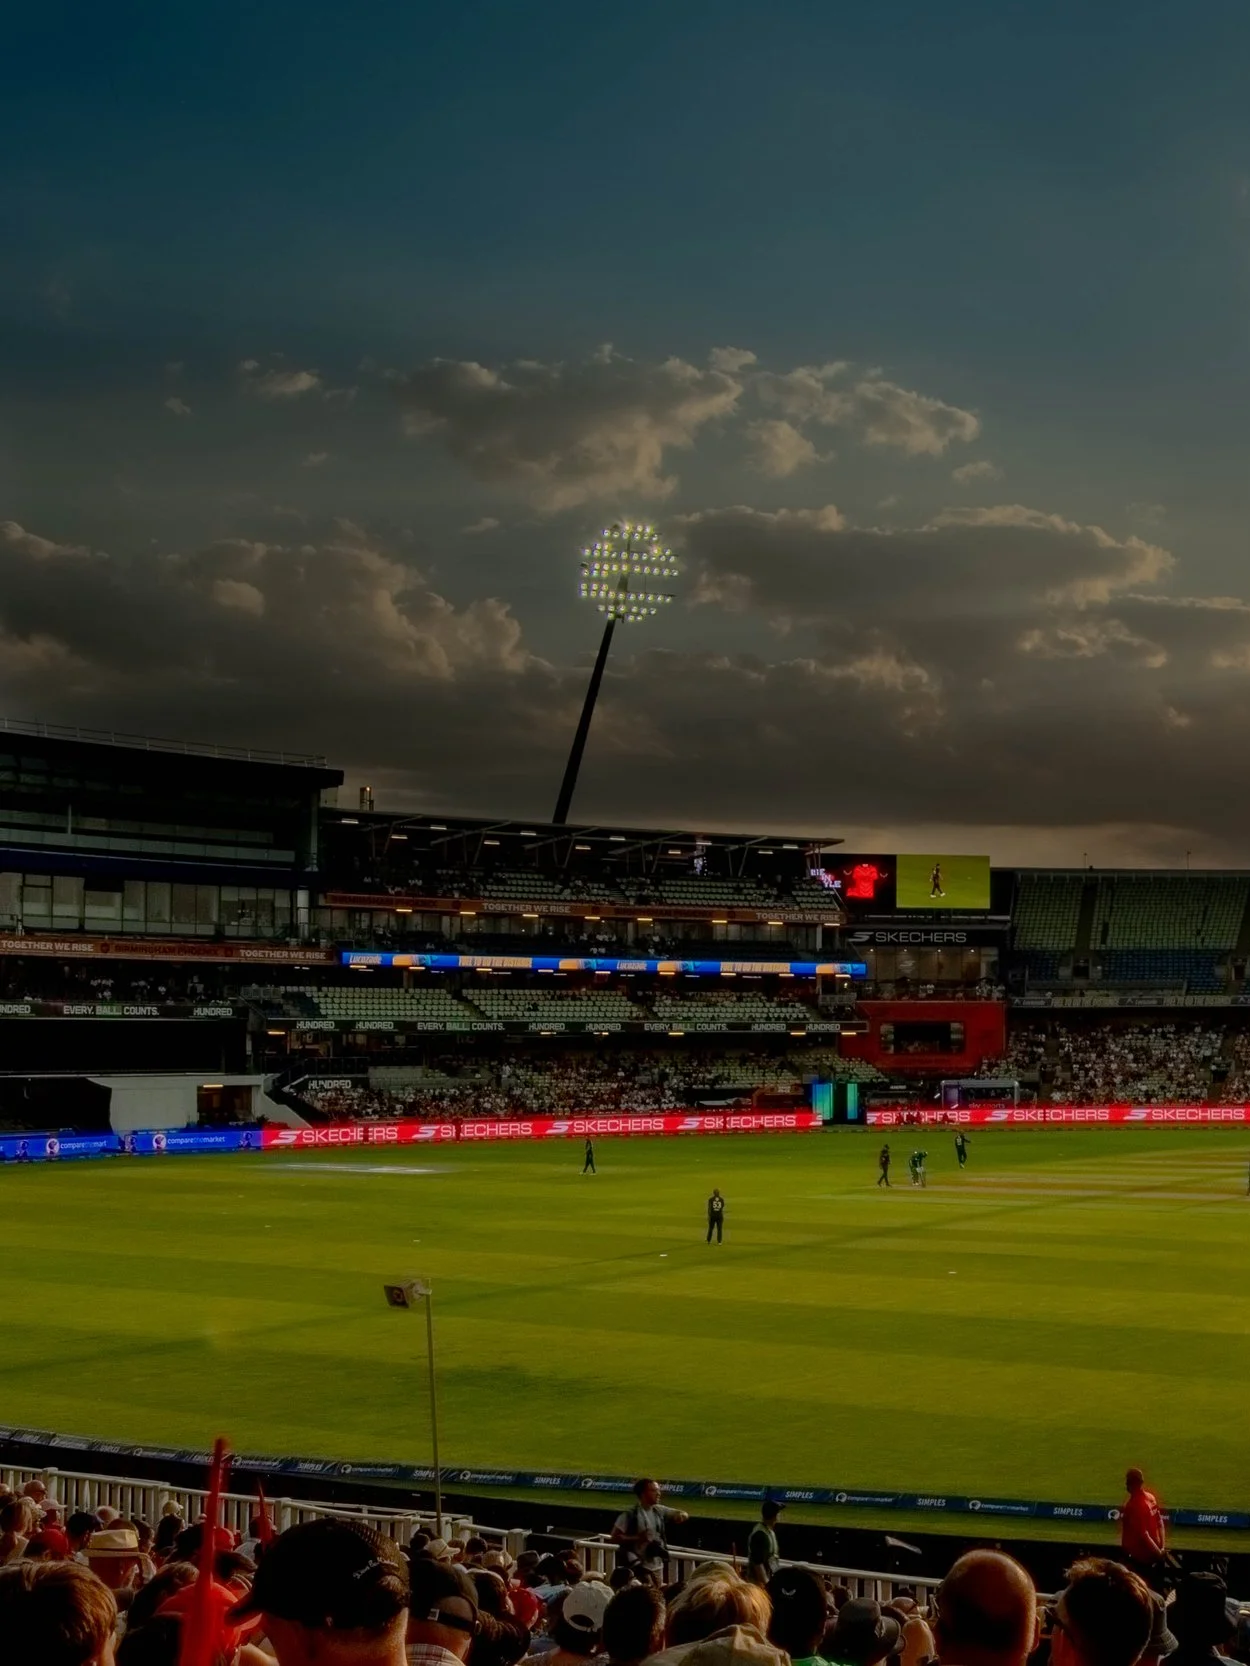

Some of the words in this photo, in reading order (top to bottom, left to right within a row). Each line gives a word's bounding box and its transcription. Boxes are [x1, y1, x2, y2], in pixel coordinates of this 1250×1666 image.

[482, 902, 533, 912] TOGETHER
[534, 904, 550, 912] WE
[551, 904, 571, 913] RISE
[755, 911, 803, 921] TOGETHER
[804, 912, 819, 921] WE
[820, 913, 840, 921] RISE
[875, 931, 967, 943] SKECHERS
[1, 940, 53, 951] TOGETHER
[54, 942, 71, 951] WE
[72, 943, 94, 952] RISE
[239, 949, 289, 959] TOGETHER
[290, 950, 305, 959] WE
[306, 951, 326, 960] RISE
[123, 1006, 160, 1016] COUNTS.
[193, 1007, 233, 1016] HUNDRED
[296, 1020, 336, 1030] HUNDRED
[355, 1021, 395, 1030] HUNDRED
[471, 1022, 506, 1031] COUNTS.
[528, 1022, 566, 1031] HUNDRED
[585, 1023, 622, 1032] HUNDRED
[751, 1023, 787, 1032] HUNDRED
[805, 1023, 841, 1032] HUNDRED
[308, 1080, 352, 1090] HUNDRED
[1151, 1109, 1246, 1120] SKECHERS
[573, 1118, 664, 1133] SKECHERS
[704, 1114, 797, 1129] SKECHERS
[534, 1477, 561, 1486] SIMPLES
[785, 1490, 814, 1499] SIMPLES
[917, 1498, 947, 1507] SIMPLES
[1053, 1506, 1084, 1517] SIMPLES
[1197, 1514, 1228, 1524] SIMPLES
